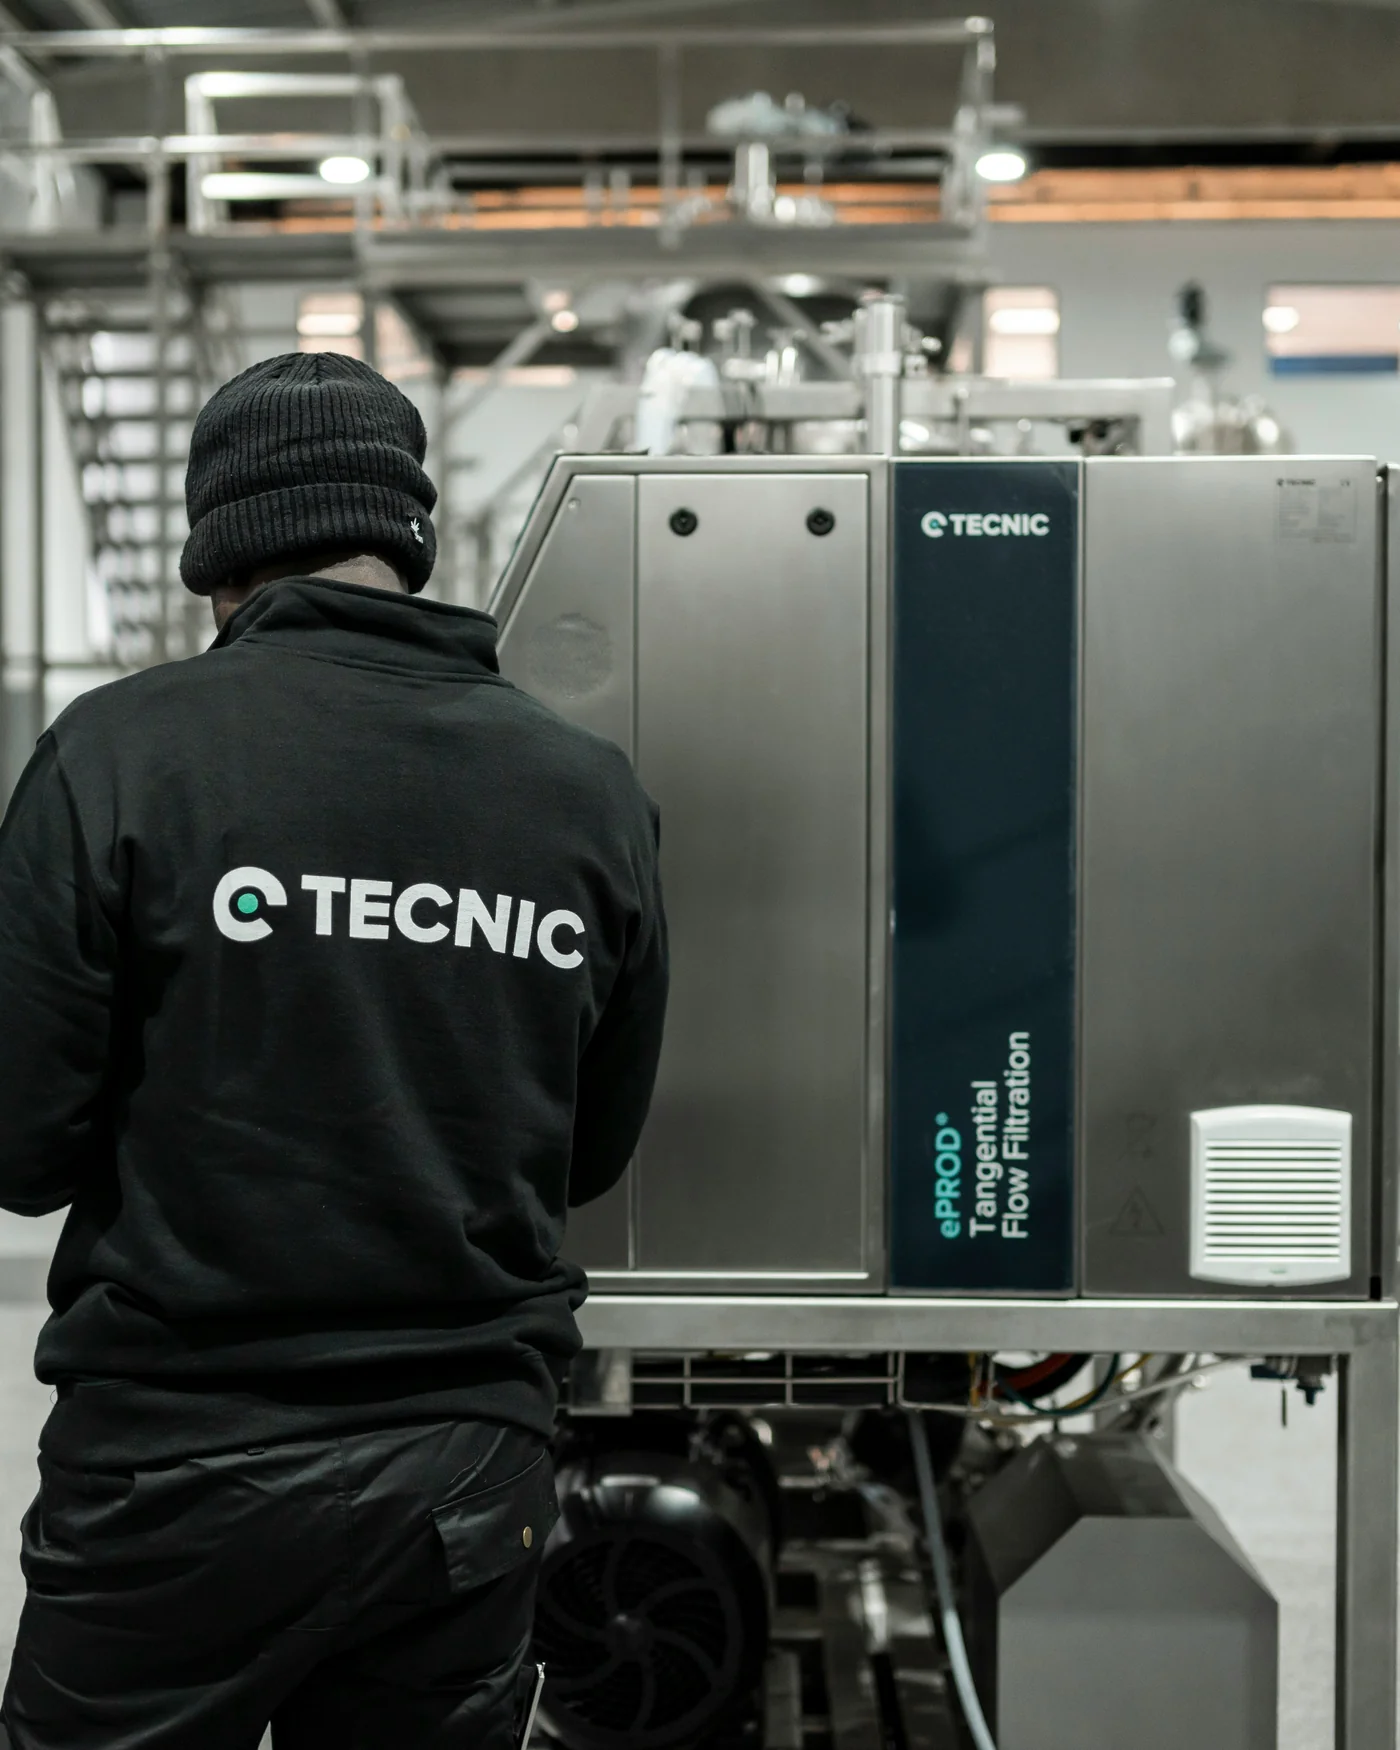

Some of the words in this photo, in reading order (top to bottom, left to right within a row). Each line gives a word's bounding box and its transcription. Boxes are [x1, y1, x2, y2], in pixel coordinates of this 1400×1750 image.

[949, 513, 1050, 536] TECNIC
[301, 874, 586, 969] TECNIC
[1002, 1031, 1031, 1160] Filtration
[969, 1080, 1004, 1239] Tangential
[1001, 1166, 1030, 1239] Flow
